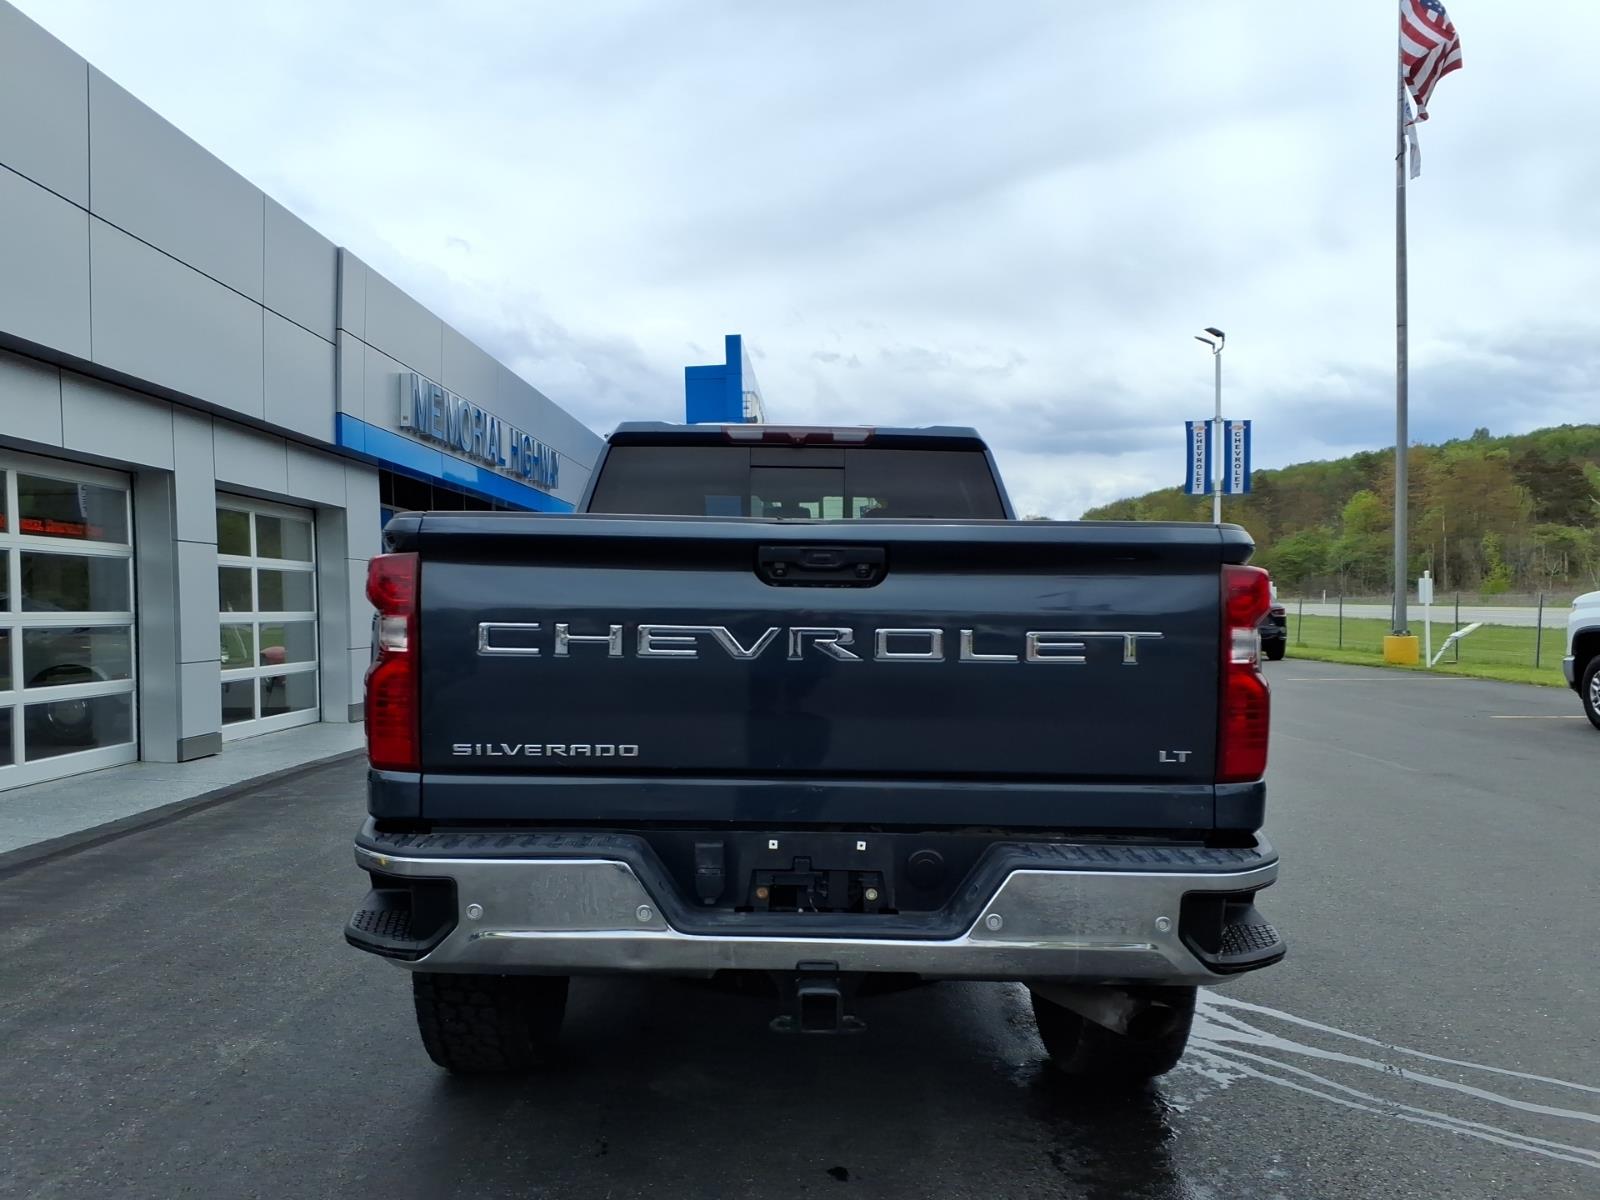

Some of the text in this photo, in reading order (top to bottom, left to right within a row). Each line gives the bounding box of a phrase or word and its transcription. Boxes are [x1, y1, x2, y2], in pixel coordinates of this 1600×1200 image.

[410, 373, 506, 467] MEMORIAL
[477, 622, 1164, 665] CHEVROLET
[452, 743, 639, 757] SILVERADO
[1159, 750, 1193, 763] LT
